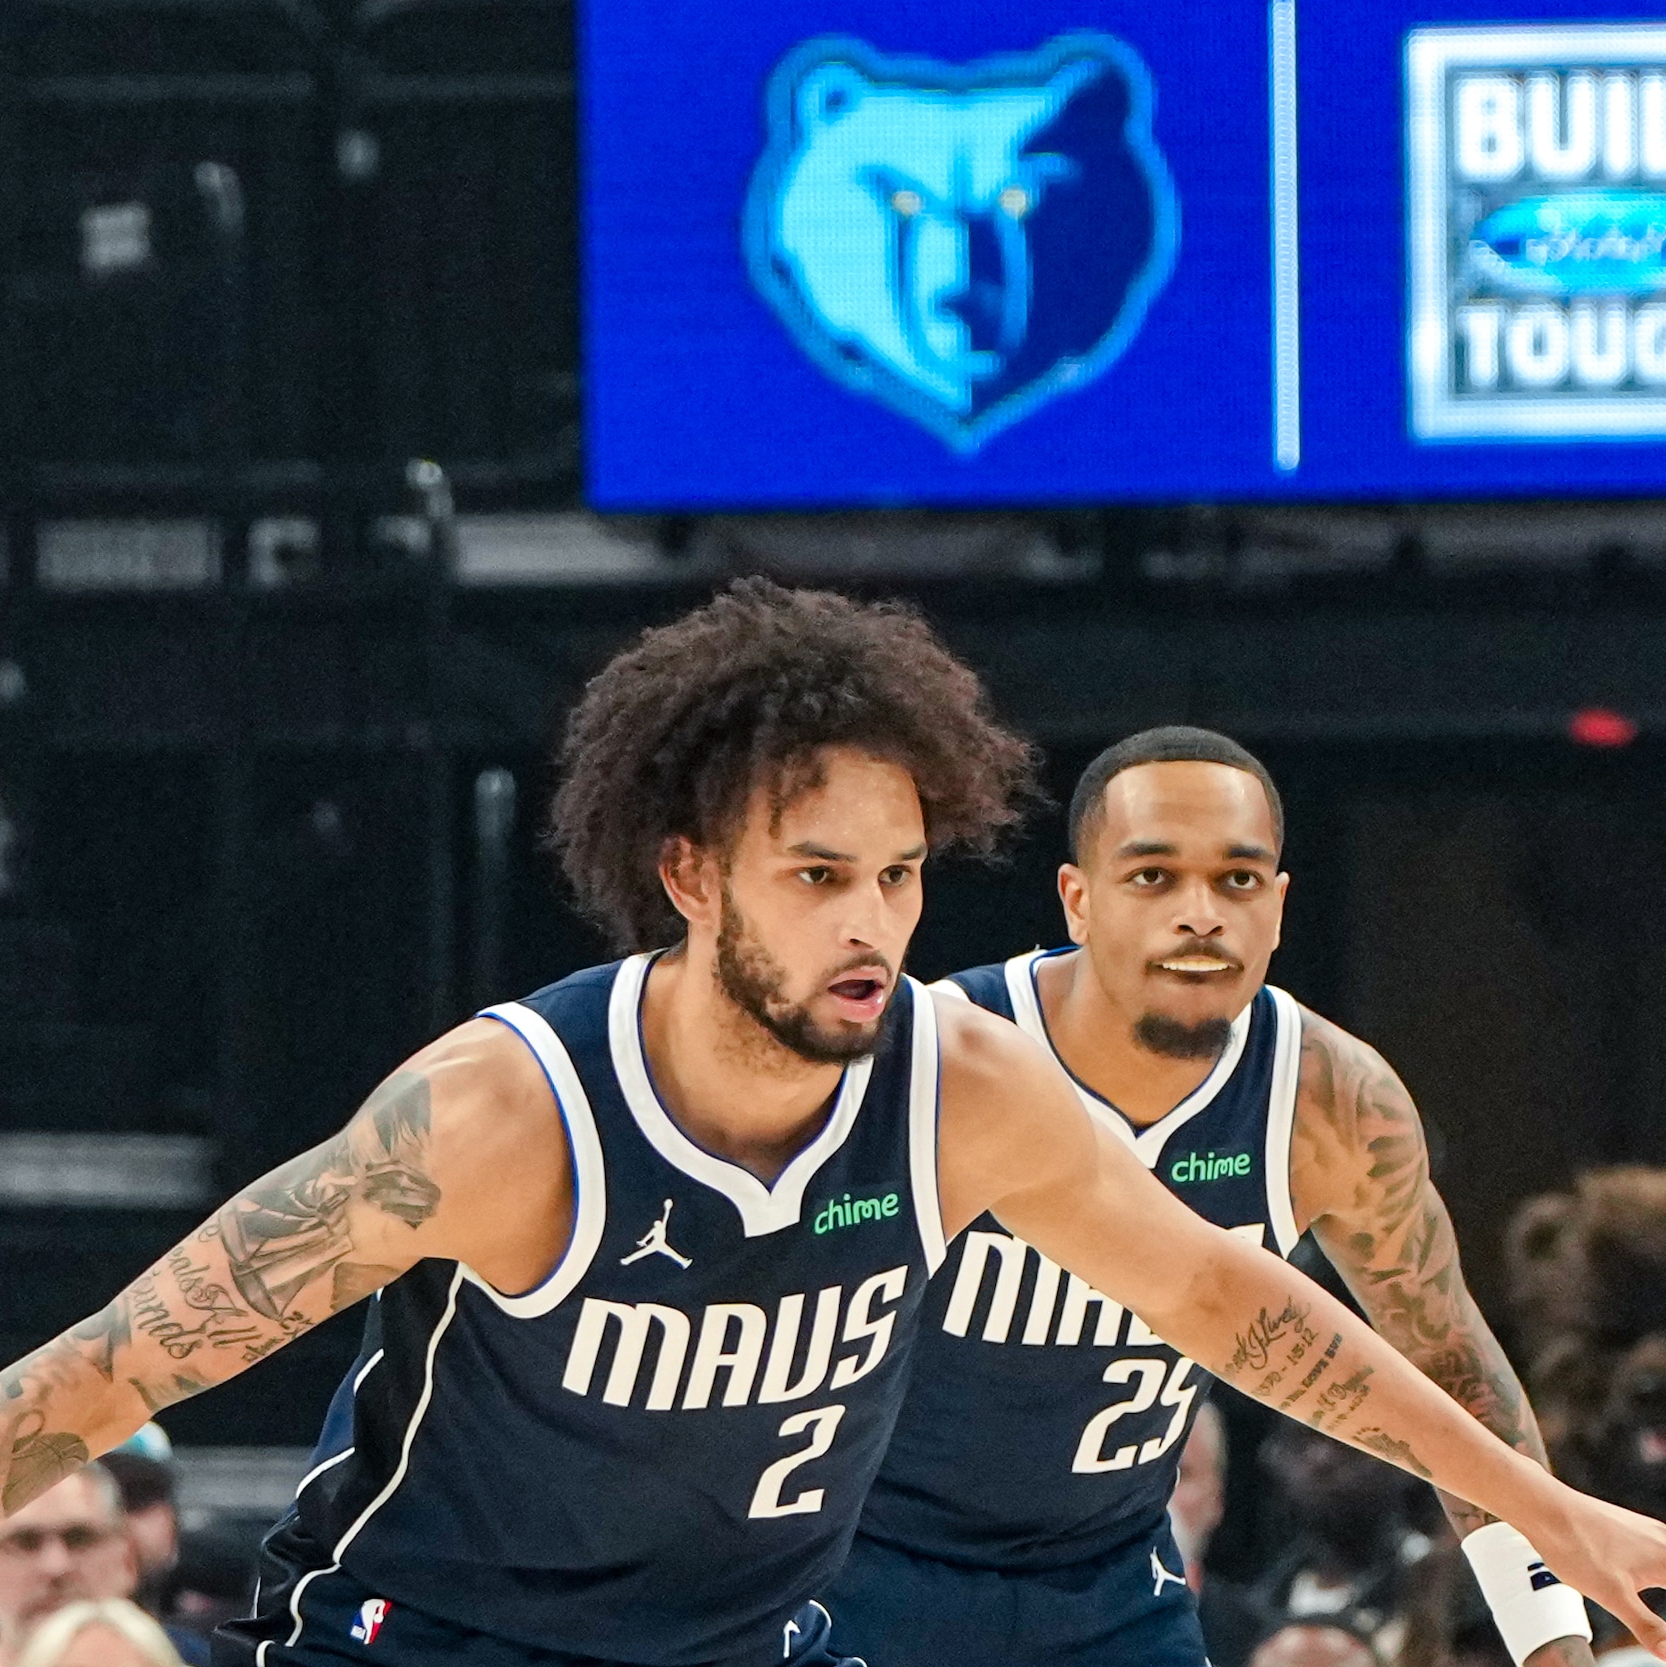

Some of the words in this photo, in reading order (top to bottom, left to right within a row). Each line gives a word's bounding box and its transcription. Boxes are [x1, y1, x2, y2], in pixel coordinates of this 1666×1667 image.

[814, 1193, 899, 1234] chime
[1171, 1152, 1251, 1183] chime
[562, 1265, 908, 1411] MAVS
[748, 1404, 845, 1519] 2
[1071, 1356, 1198, 1474] 25
